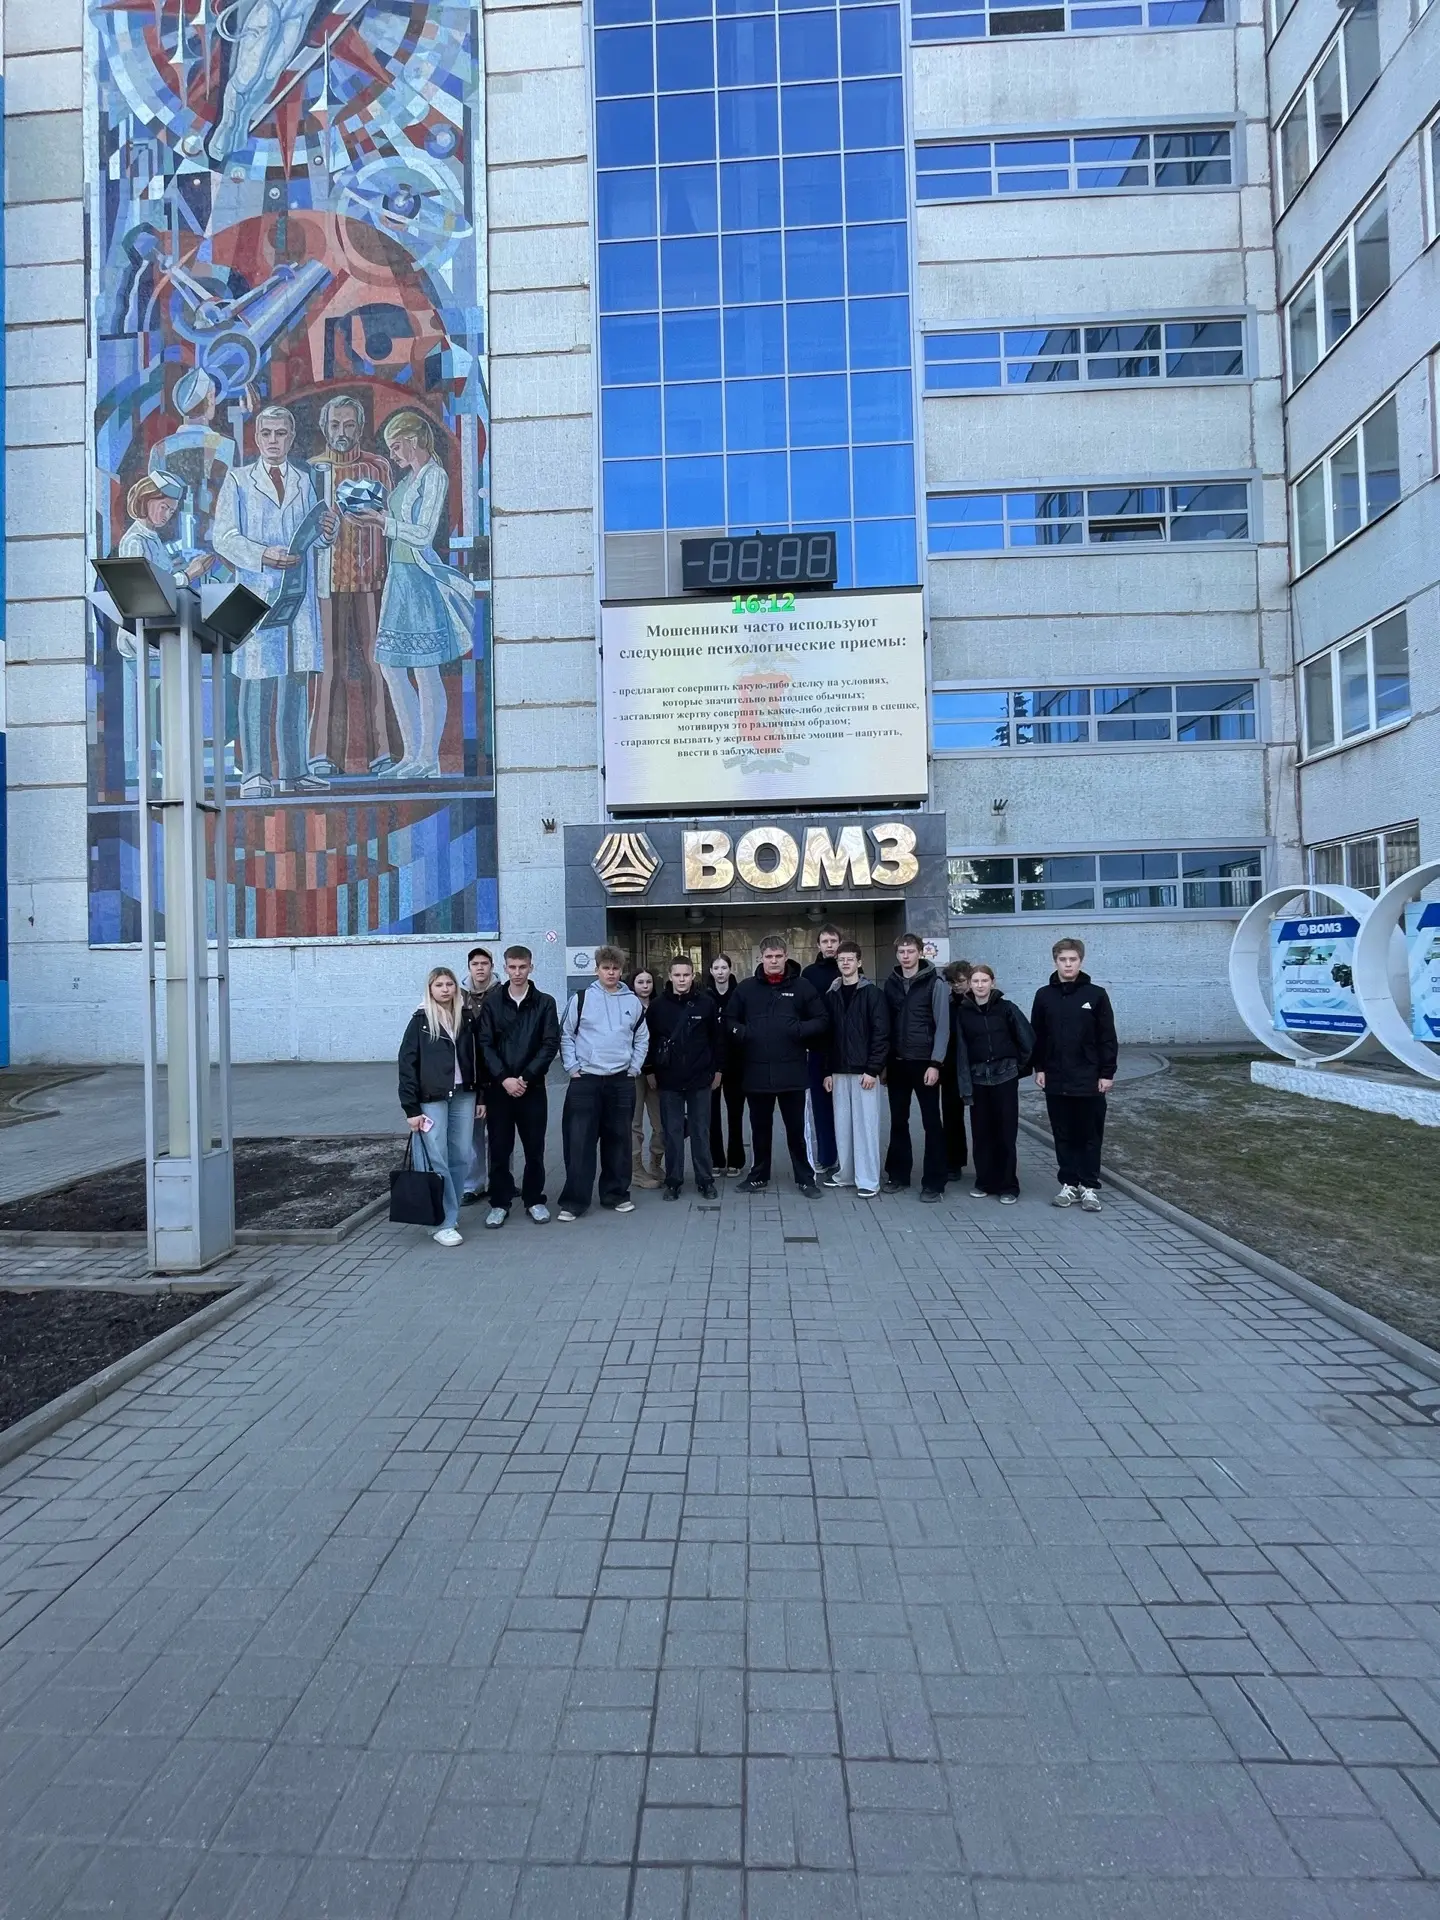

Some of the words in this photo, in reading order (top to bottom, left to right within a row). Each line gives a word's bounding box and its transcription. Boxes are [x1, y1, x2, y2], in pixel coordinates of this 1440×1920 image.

[732, 593, 795, 613] 16:12
[646, 625, 738, 637] Мошенники
[744, 622, 784, 633] часто
[789, 617, 878, 631] используют
[620, 646, 703, 660] следующие
[707, 640, 836, 655] психологические
[840, 636, 907, 652] приемы:
[619, 686, 675, 697] предлагают
[677, 684, 730, 695] совершить
[732, 679, 790, 691] какую-либо
[792, 680, 824, 690] сделку
[841, 677, 889, 688] условиях,
[662, 698, 702, 708] которые
[704, 695, 766, 706] значительно
[768, 694, 814, 703] выгоднее
[815, 691, 865, 701] обычных;
[619, 712, 674, 721] заставляют
[676, 711, 712, 720] жертву
[713, 709, 765, 719] совершать
[767, 705, 822, 715] какие-либо
[824, 703, 869, 713] действия
[880, 702, 920, 711] спешке,
[677, 723, 730, 732] мотивируя
[750, 720, 806, 731] различным
[808, 718, 851, 728] образом;
[620, 737, 670, 747] стараются
[673, 736, 713, 745] вызвать
[715, 736, 721, 744] у
[723, 734, 761, 743] жертвы
[763, 732, 806, 742] сильные
[808, 731, 844, 740] эмоции
[855, 728, 903, 739] напугать,
[677, 749, 710, 758] ввести
[720, 746, 784, 757] заблуждение.
[681, 823, 919, 893] ВОМЗ
[1309, 922, 1342, 935] ВОМЗ
